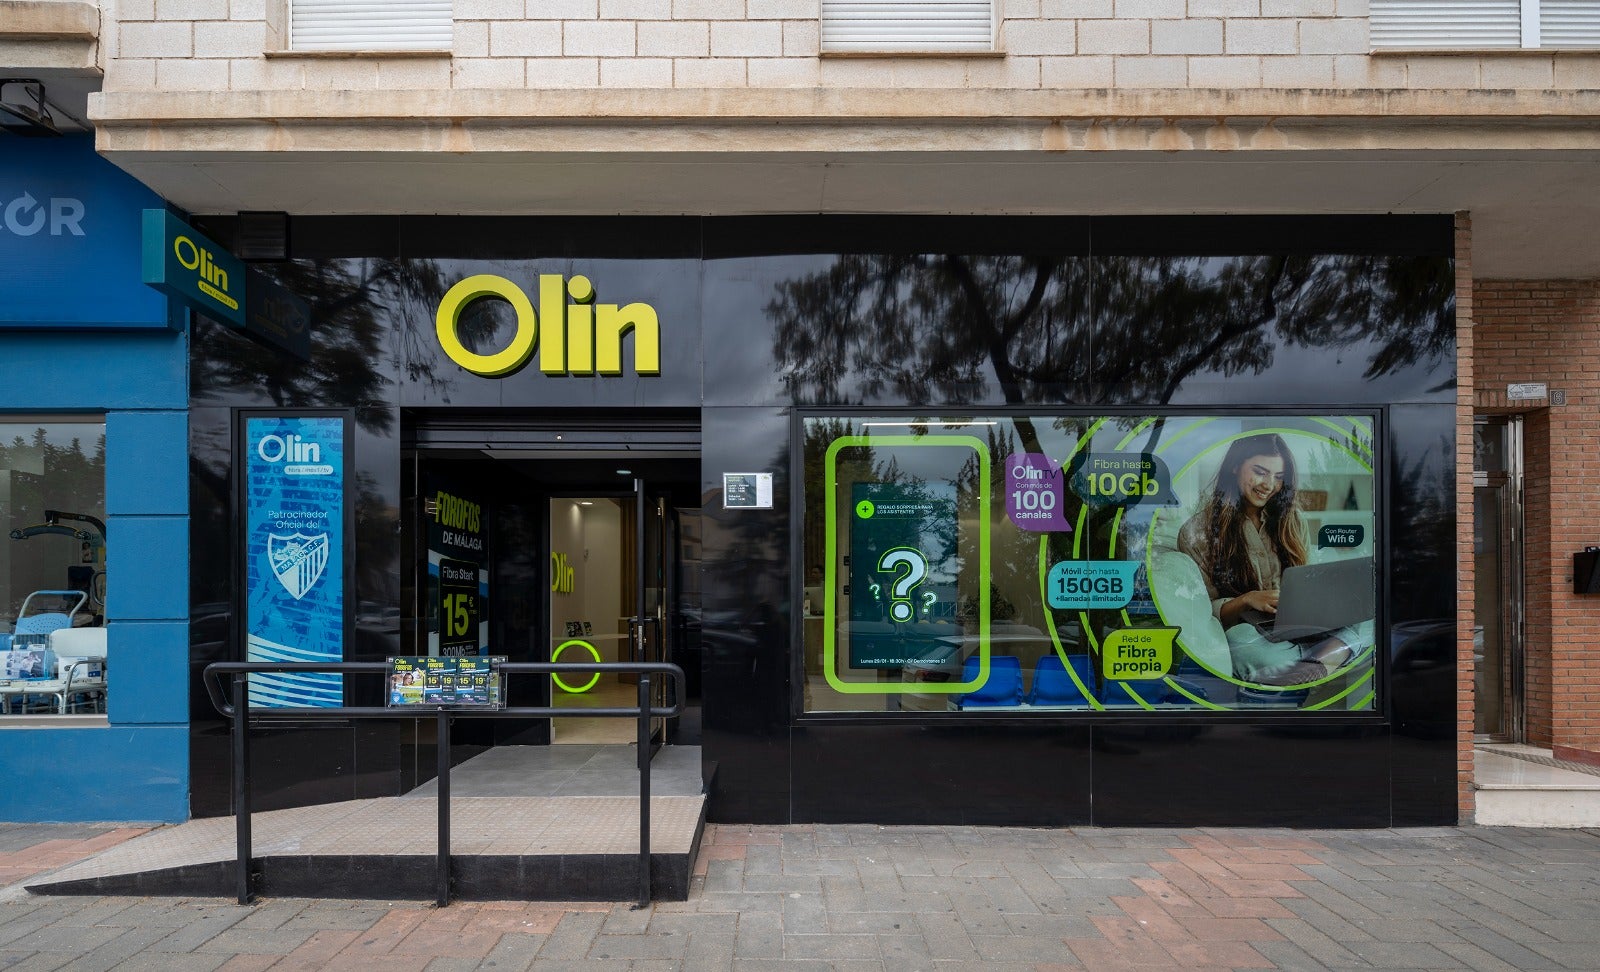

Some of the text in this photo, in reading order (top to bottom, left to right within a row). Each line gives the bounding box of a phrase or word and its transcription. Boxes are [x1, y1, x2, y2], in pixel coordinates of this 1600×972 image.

[0, 190, 86, 237] OR
[174, 235, 229, 292] Olin
[436, 274, 660, 376] Olin
[1553, 391, 1562, 404] 6
[258, 434, 320, 463] Olin
[1094, 459, 1151, 469] Fibra hasta
[1087, 472, 1160, 496] 10Gb
[1012, 490, 1056, 510] 100
[268, 511, 328, 519] Patrocinador
[435, 490, 481, 534] FOROFOS
[1015, 510, 1053, 519] canales
[276, 520, 320, 529] Oficial del
[442, 530, 482, 551] DE MÁLAGA
[1327, 534, 1355, 543] Wifi 6
[442, 566, 474, 581] Fibra Start
[552, 551, 575, 593] Olin
[1061, 567, 1081, 575] Móvil
[1099, 567, 1119, 575] hasta
[1057, 577, 1124, 594] 150GB
[443, 593, 469, 637] 15
[1122, 635, 1152, 643] Red de
[1118, 645, 1157, 658] Fibra
[1113, 659, 1162, 675] propia
